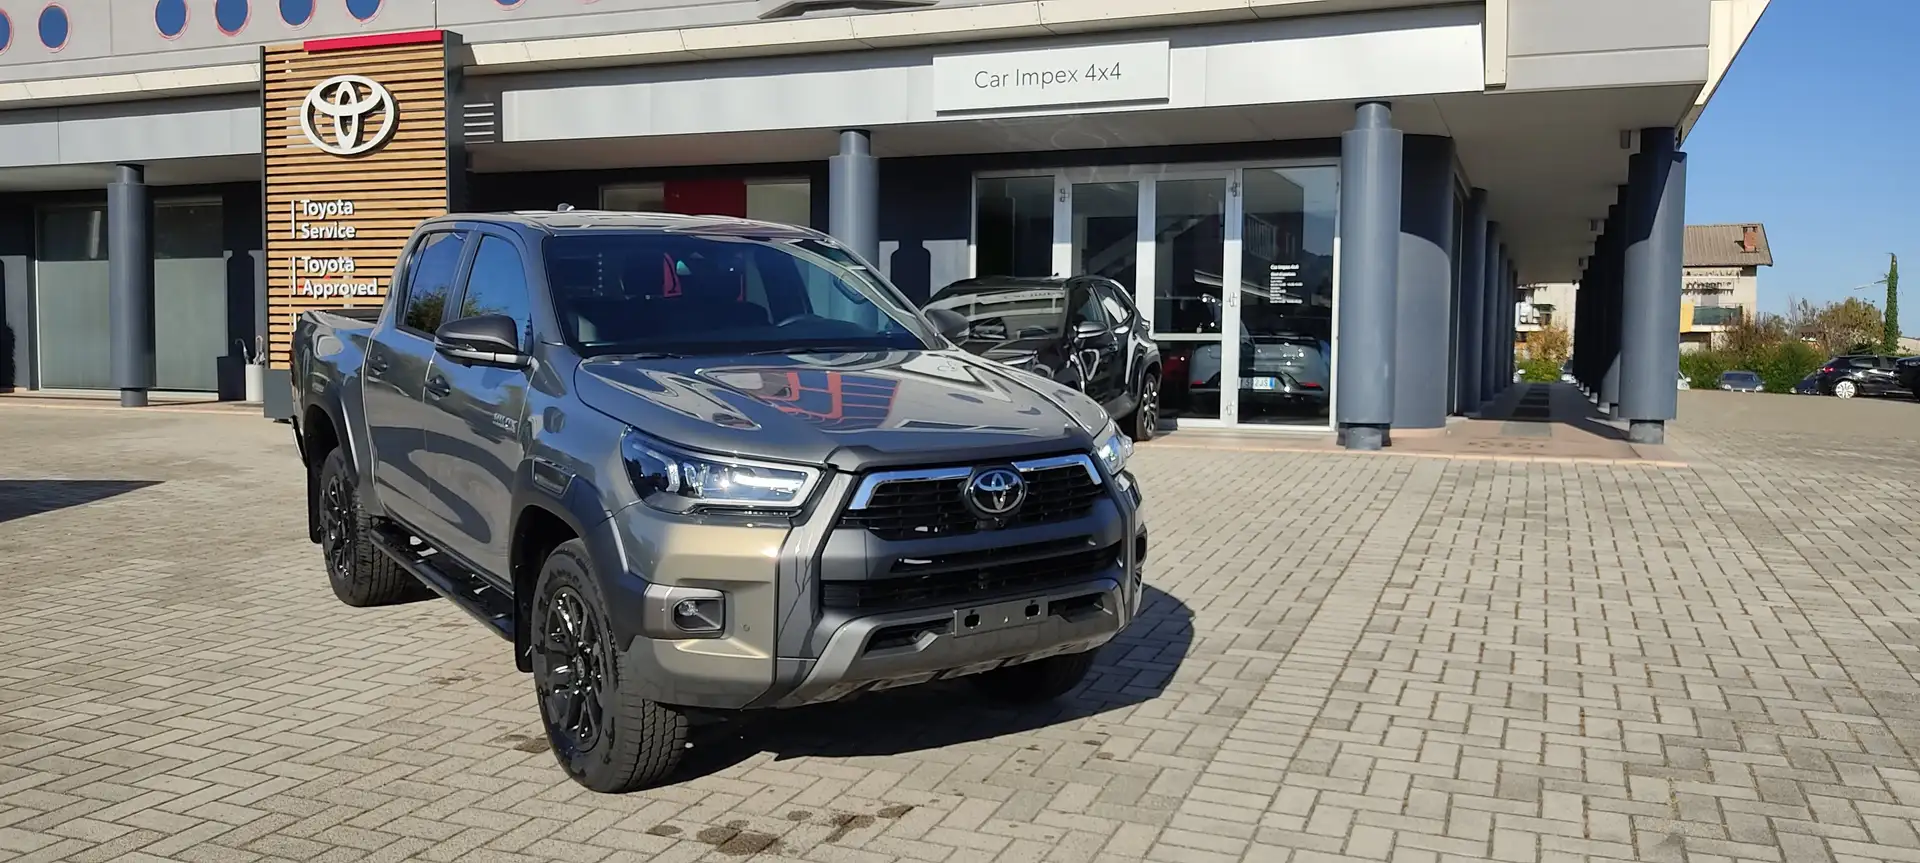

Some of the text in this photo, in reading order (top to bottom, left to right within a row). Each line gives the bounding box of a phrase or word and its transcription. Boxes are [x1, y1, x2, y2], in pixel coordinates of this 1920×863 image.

[974, 61, 1122, 90] Car Impex 4x4
[300, 199, 355, 220] Toyota
[301, 221, 356, 239] Service
[301, 256, 356, 277] Toyota
[302, 277, 378, 300] Approved
